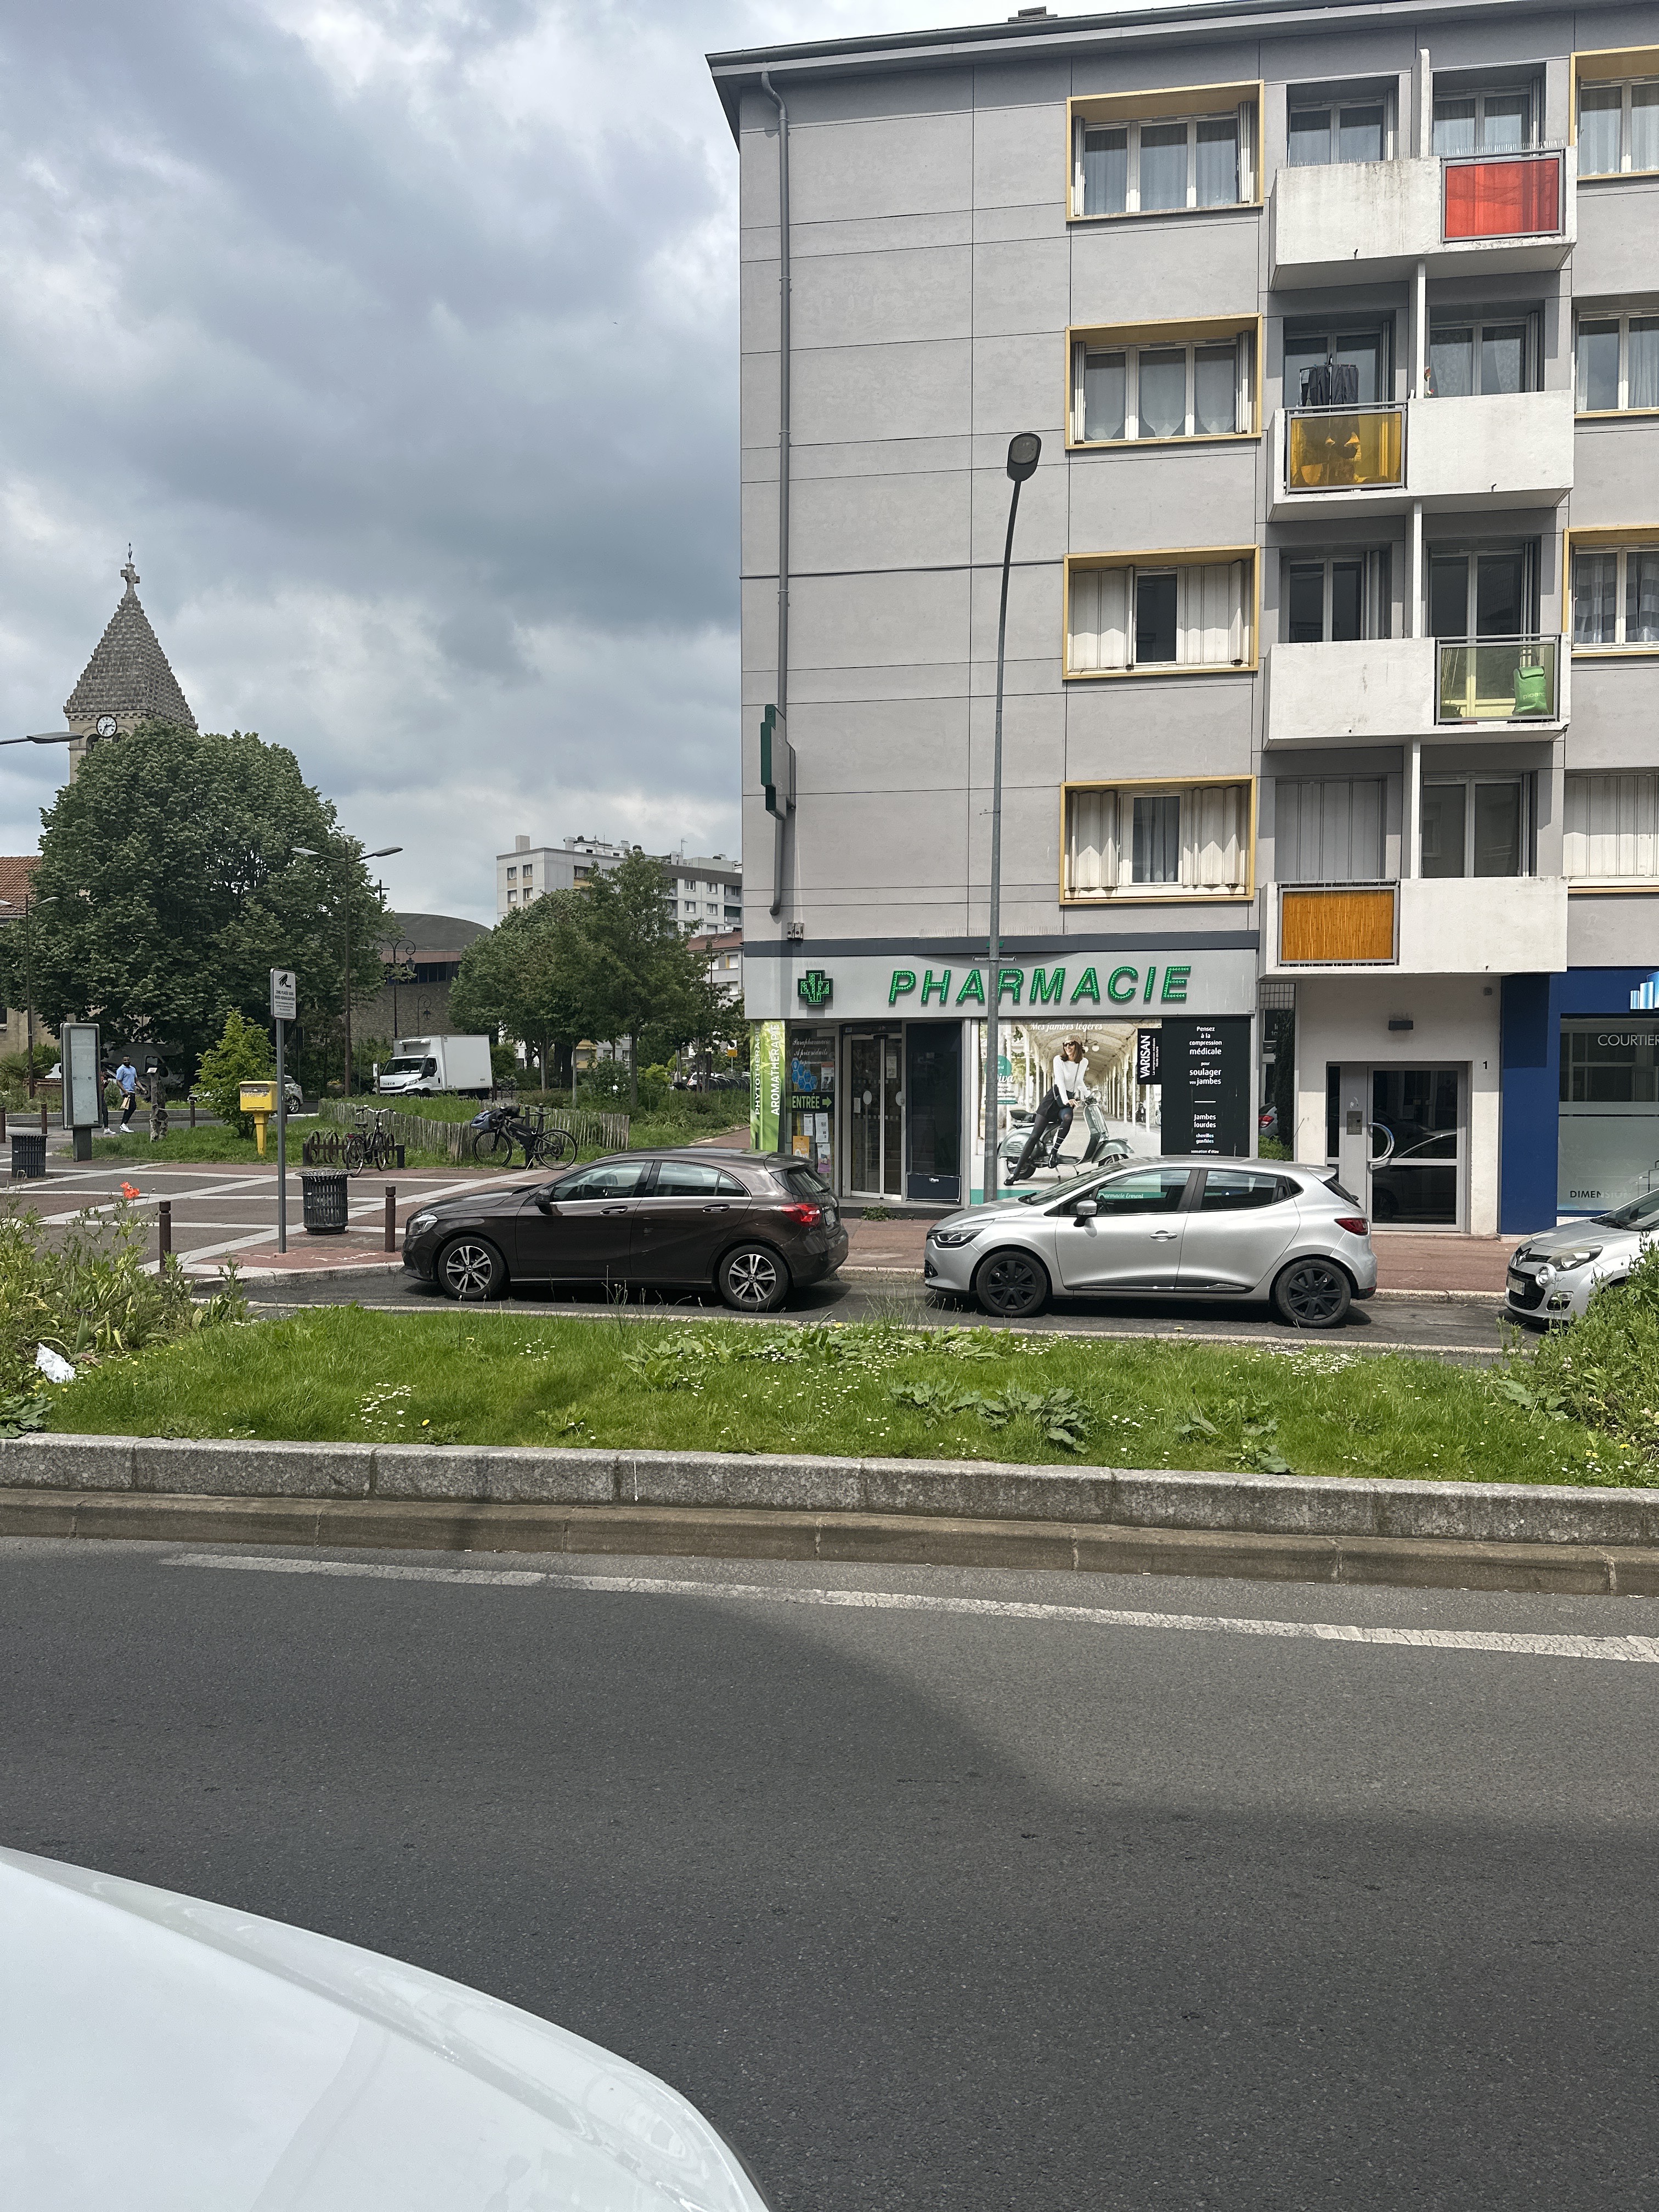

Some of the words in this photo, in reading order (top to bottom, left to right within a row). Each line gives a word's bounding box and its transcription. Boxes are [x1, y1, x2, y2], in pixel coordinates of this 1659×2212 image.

[888, 966, 1192, 1003] PHARMACIE
[1031, 1022, 1045, 1030] Mes
[1045, 1023, 1074, 1032] jambes
[1075, 1022, 1103, 1032] légères
[1140, 1035, 1151, 1079] VARISAN
[769, 1024, 780, 1115] AROMATHÉRAPIE
[1482, 1060, 1487, 1070] 1
[1189, 1068, 1222, 1077] soulager
[1196, 1077, 1221, 1086] jambes
[792, 1092, 820, 1109] ENTRÉE
[1570, 1190, 1632, 1199] DIMENSION
